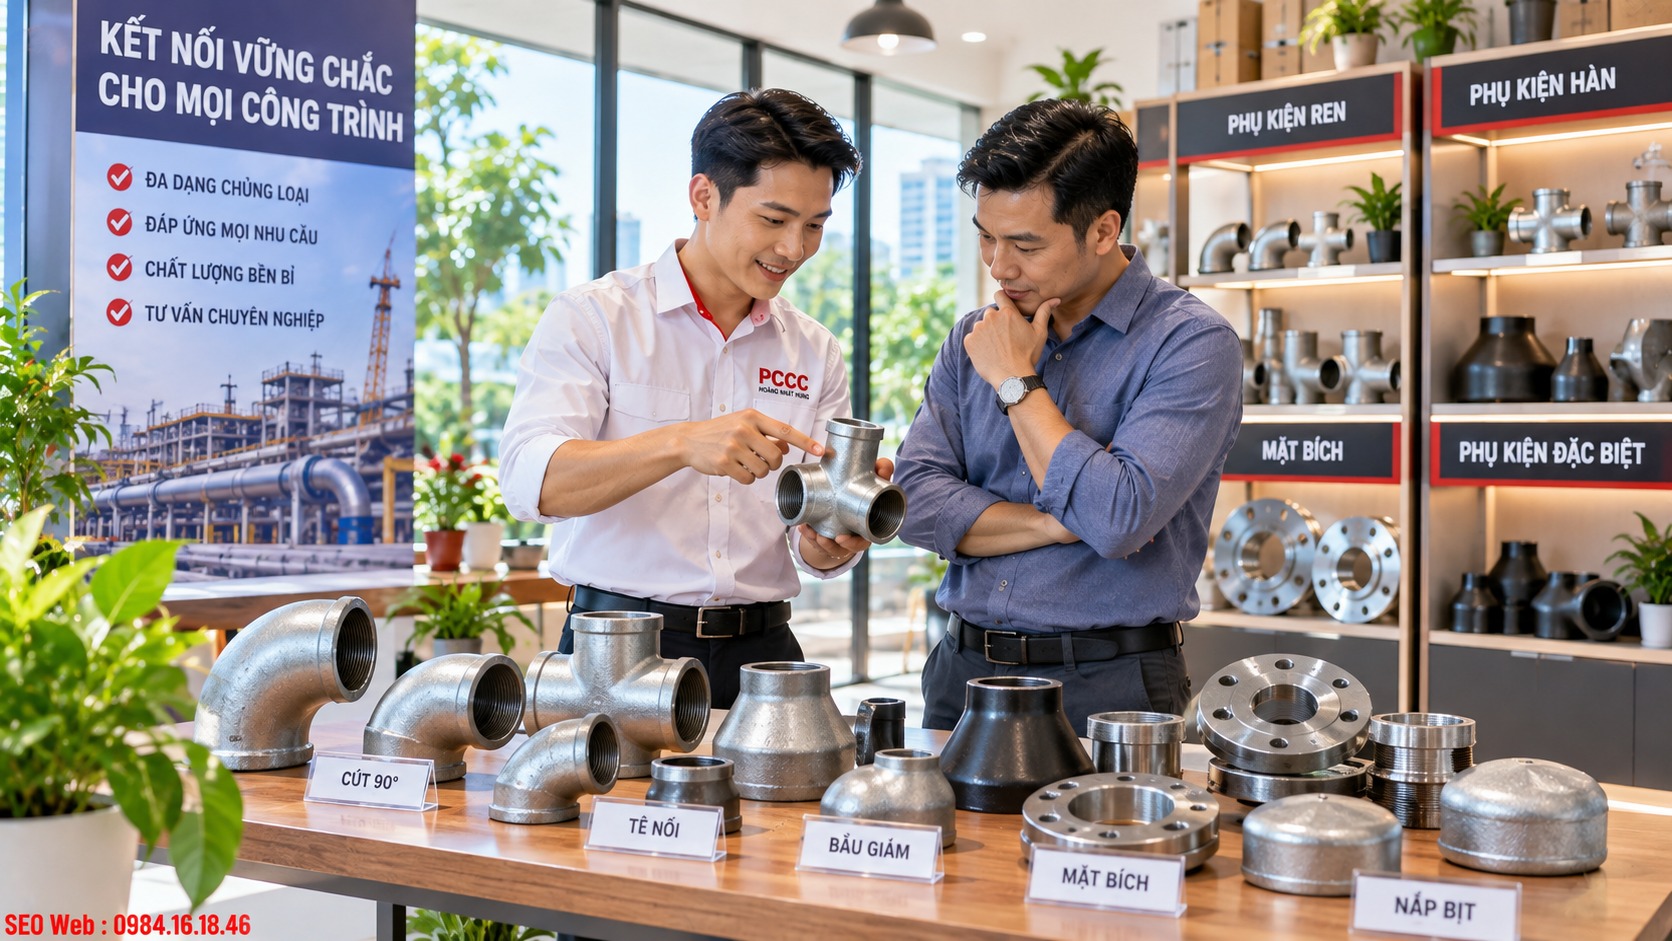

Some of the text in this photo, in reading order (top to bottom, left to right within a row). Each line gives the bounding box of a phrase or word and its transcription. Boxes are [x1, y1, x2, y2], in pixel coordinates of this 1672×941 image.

[101, 14, 393, 96] KẾT NỐI VỮNG CHẮC
[1470, 64, 1616, 107] PHỤ KIỆN HÀN
[98, 71, 404, 143] CHO MỌI CÔNG TRÌNH
[1228, 100, 1346, 136] PHỤ KIỆN REN
[145, 171, 309, 206] ĐA DẠNG CHỦNG LOẠI
[145, 213, 178, 234] ĐÁP
[183, 215, 216, 237] ỨNG
[221, 222, 249, 243] MỌI
[254, 225, 285, 243] NHU
[145, 256, 187, 279] CHẤT
[192, 263, 243, 285] LƯỢNG
[145, 301, 325, 332] TƯ VẤN CHUYÊN NGHIỆP
[759, 367, 809, 391] PCCC
[1262, 435, 1343, 465] MẶT BÍCH
[1459, 436, 1646, 470] PHỤ KIỆN ĐẶC BIỆT
[341, 768, 371, 788] CÚT
[629, 814, 680, 838] TÊ NỐI
[1062, 864, 1149, 892] MẶT BÍCH
[1444, 901, 1476, 925] BỊT
